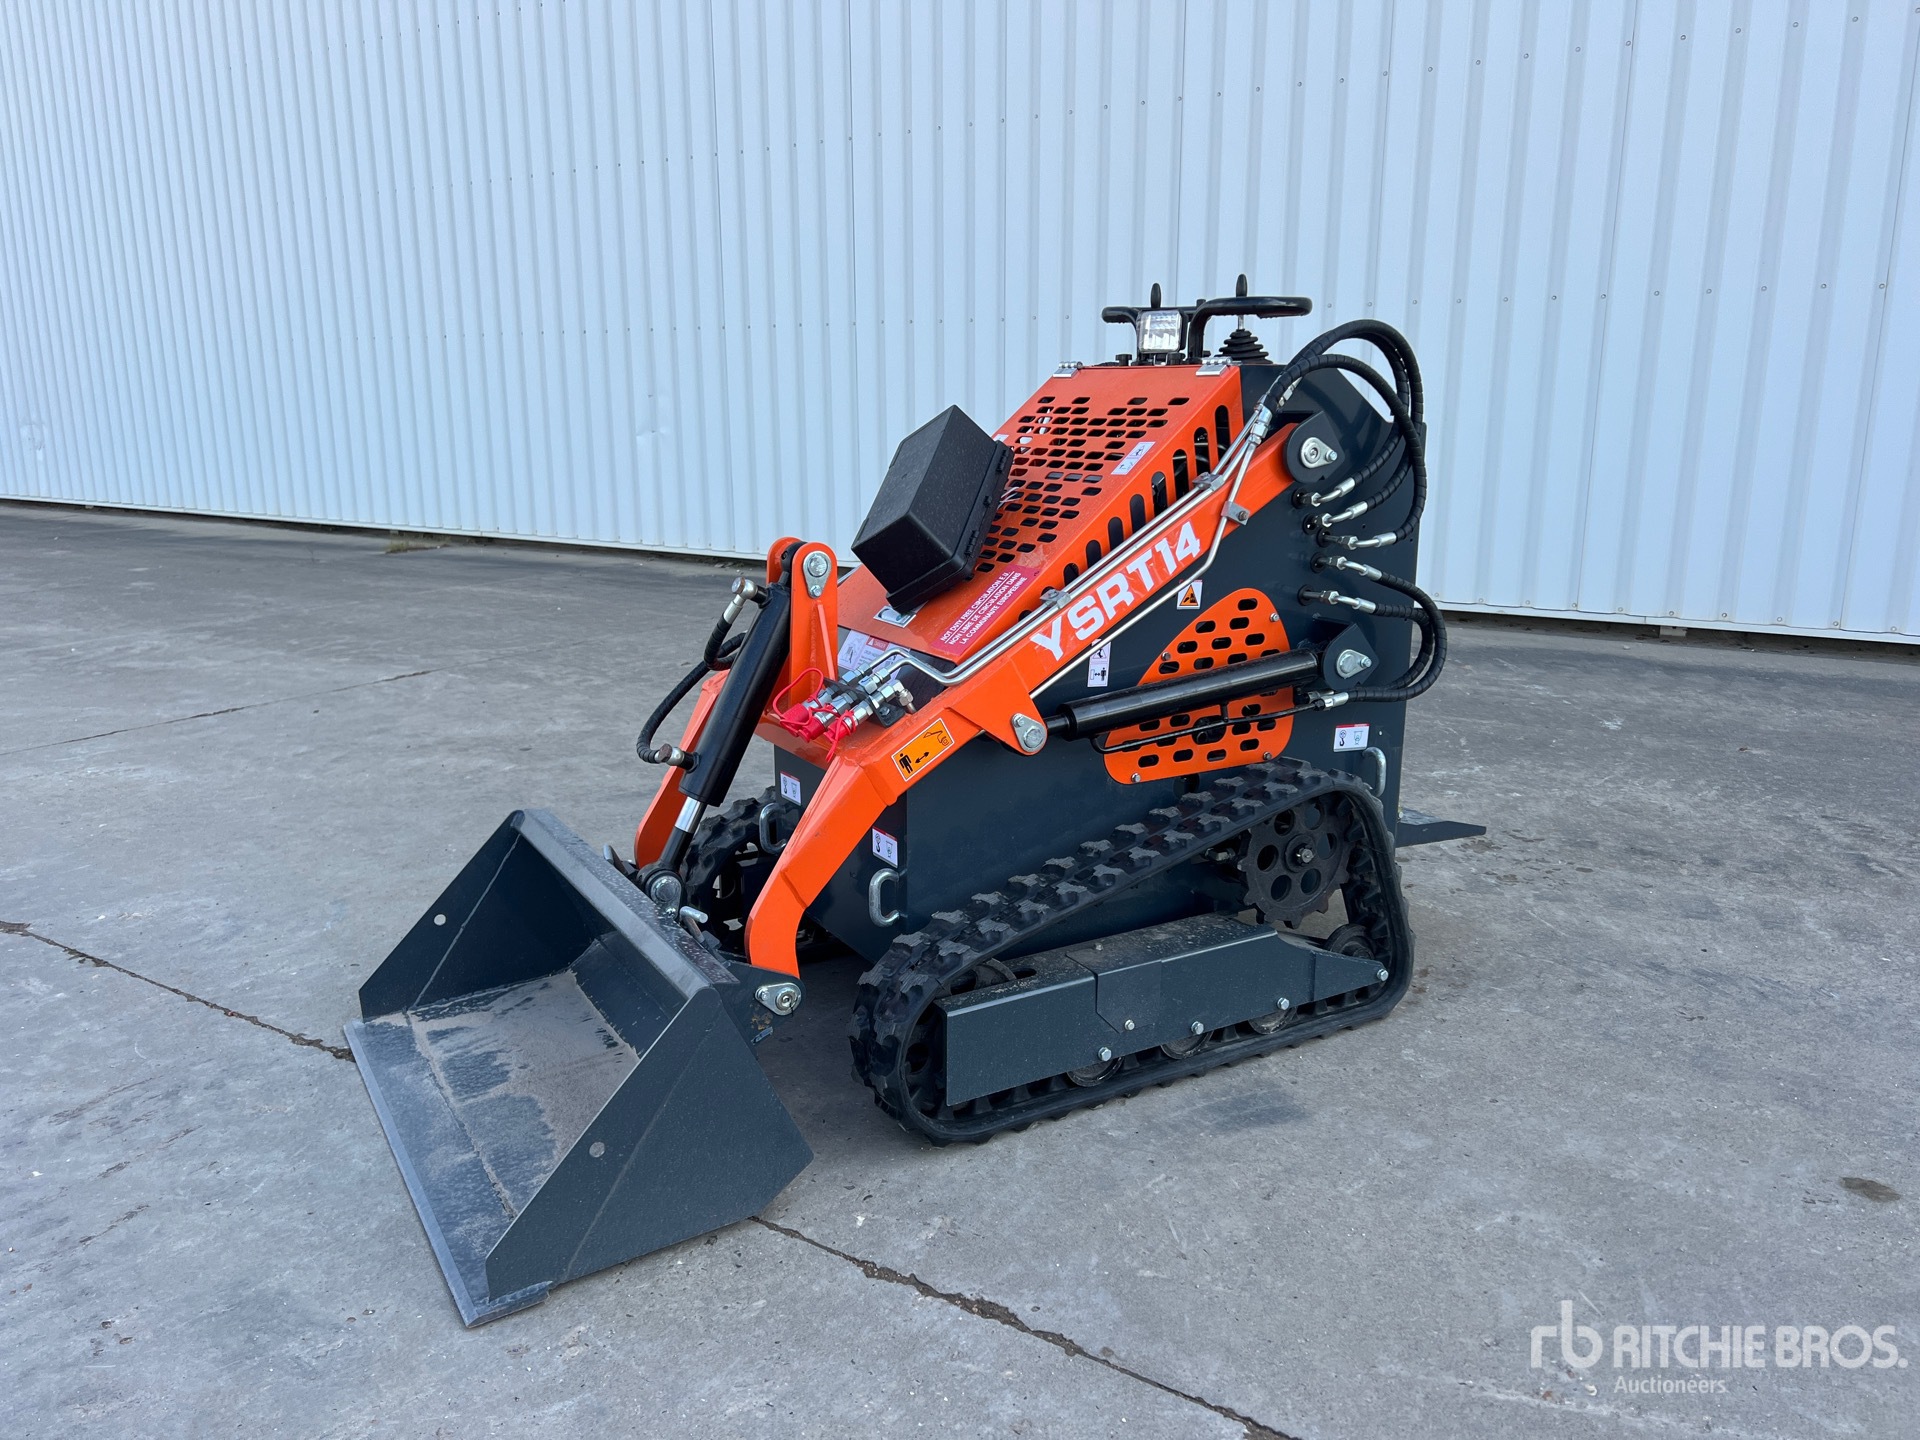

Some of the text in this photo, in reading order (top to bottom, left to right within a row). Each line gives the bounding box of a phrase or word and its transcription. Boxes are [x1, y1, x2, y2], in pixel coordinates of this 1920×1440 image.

[940, 630, 953, 641] NOT
[950, 619, 963, 631] DUTY
[960, 608, 975, 620] FREE
[971, 580, 1002, 609] CIRCULATION
[949, 633, 963, 645] NON
[960, 621, 975, 634] LIBRE
[978, 584, 1010, 614] CIRCULATION
[1005, 572, 1022, 585] DANS
[1030, 521, 1201, 661] YSRT14
